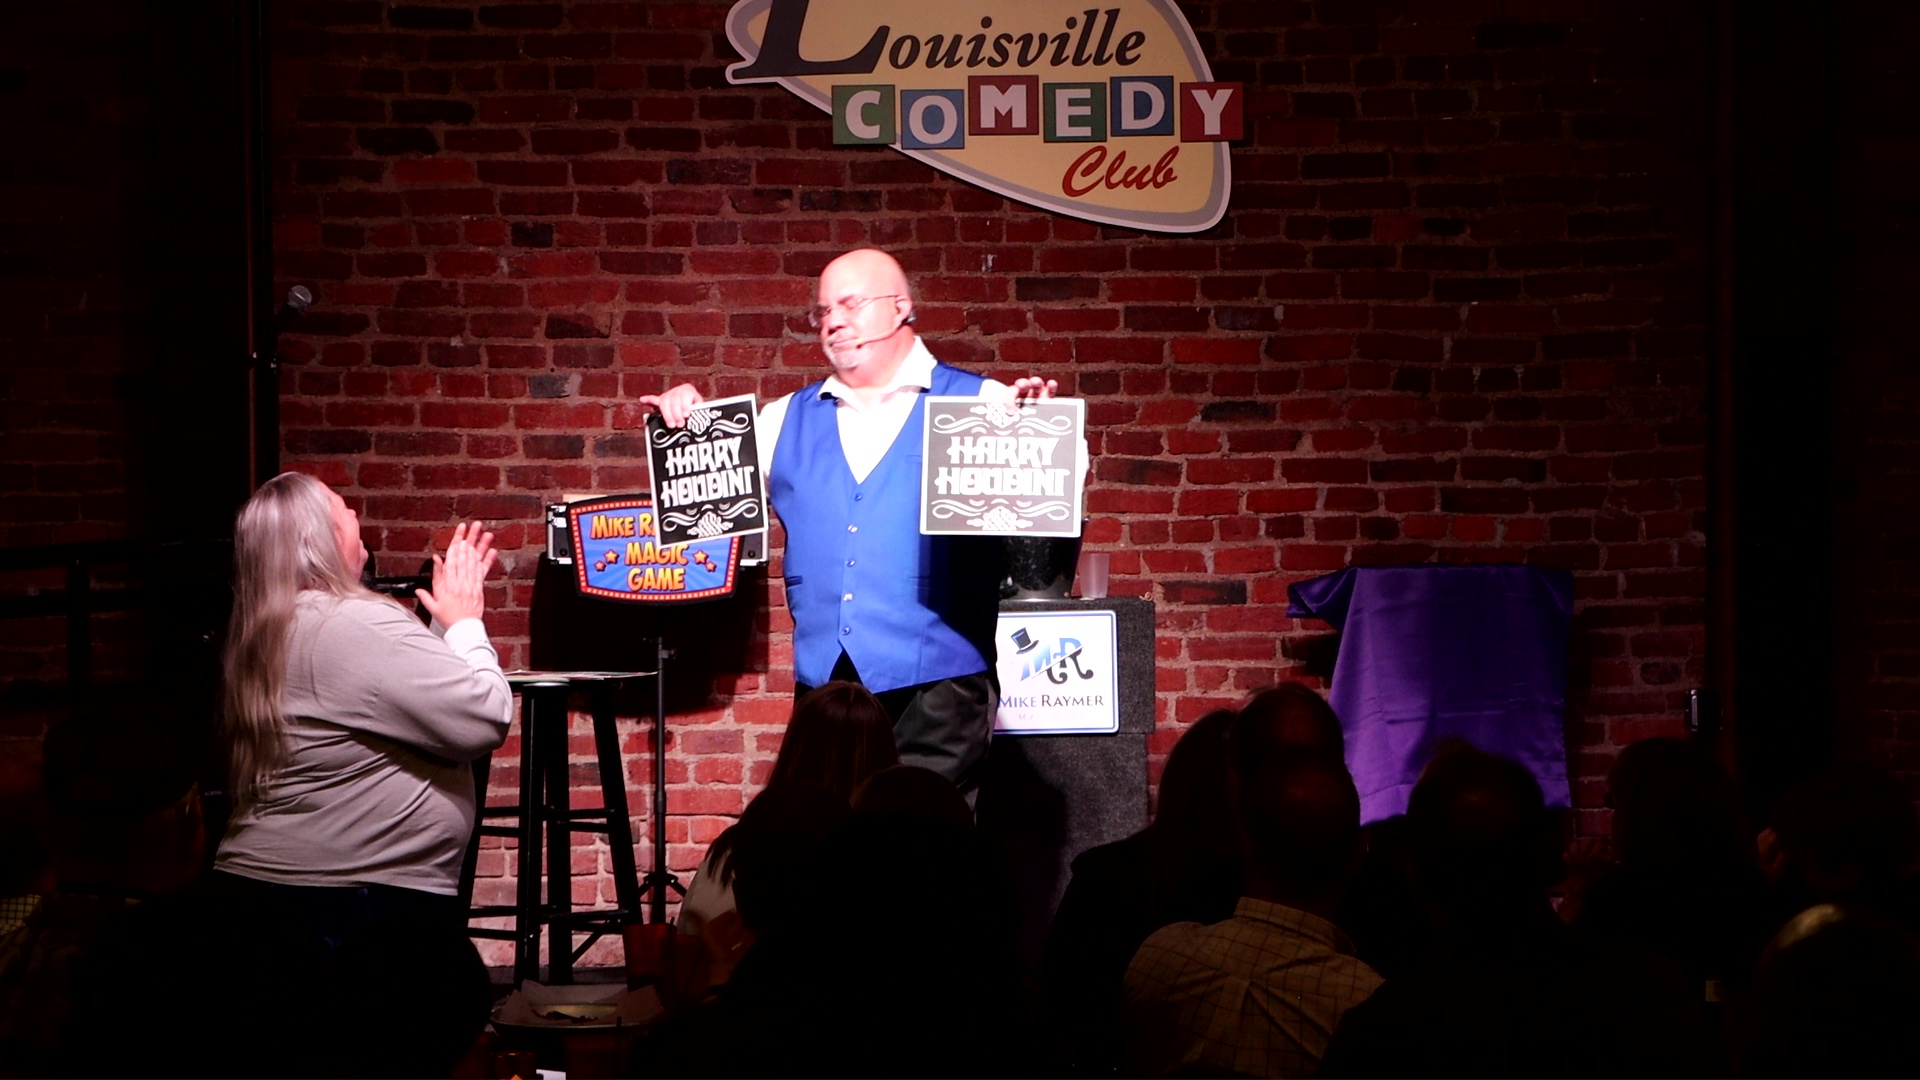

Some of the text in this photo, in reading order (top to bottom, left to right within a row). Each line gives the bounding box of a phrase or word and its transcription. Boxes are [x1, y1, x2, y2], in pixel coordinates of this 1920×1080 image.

[732, 0, 1146, 80] Louisville
[844, 81, 1234, 145] COMEDY
[1062, 145, 1180, 198] Club
[664, 436, 743, 477] HARRY
[946, 436, 1060, 468] HARRY
[660, 465, 755, 508] HOUDINI
[934, 466, 1071, 497] HOUDINI
[590, 514, 635, 539] MIKE
[624, 541, 690, 566] MAGIC
[627, 567, 686, 592] GAME
[1041, 694, 1105, 708] RAYMER
